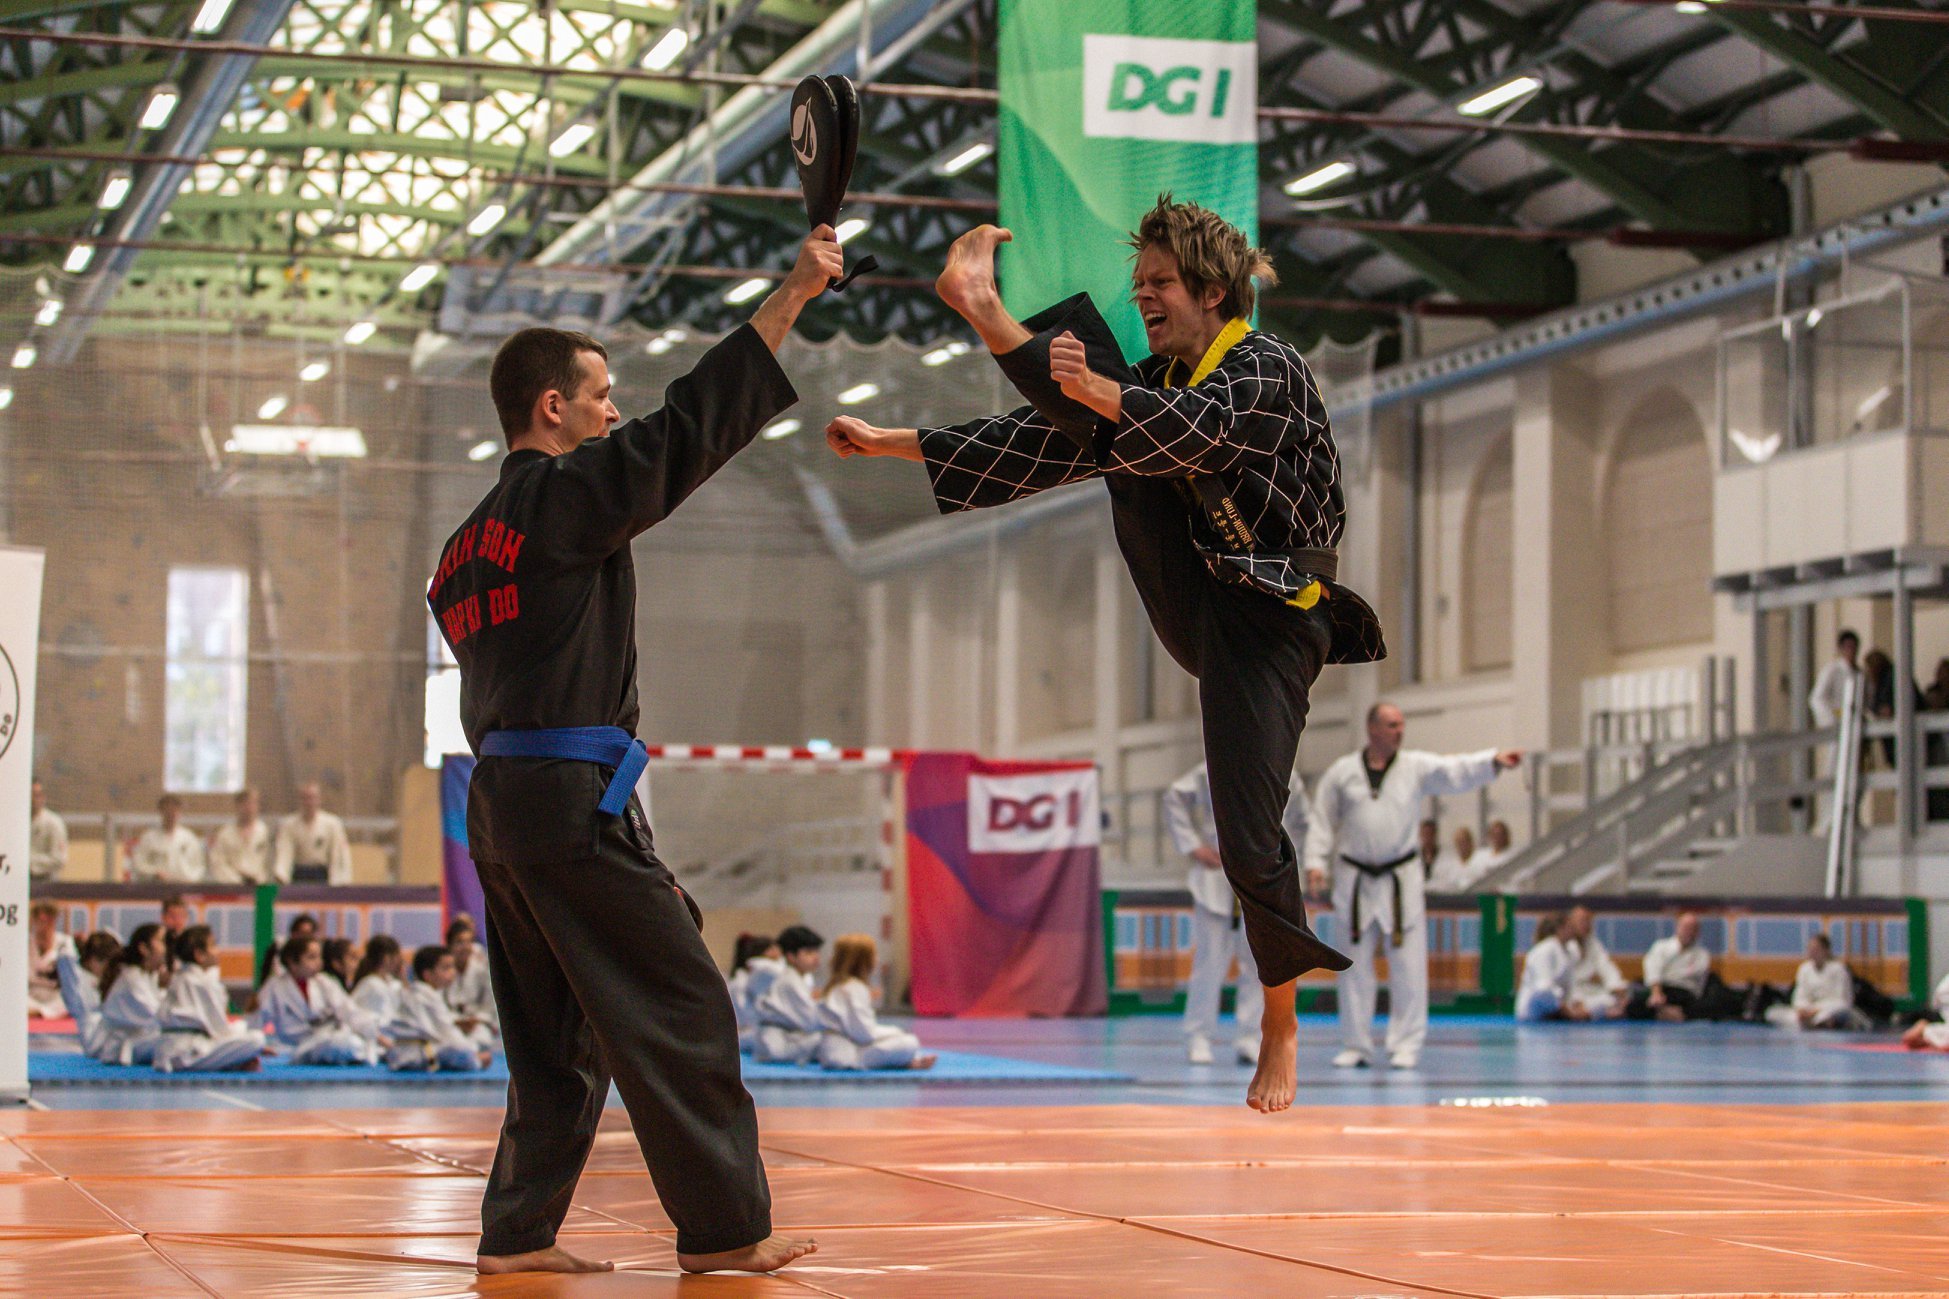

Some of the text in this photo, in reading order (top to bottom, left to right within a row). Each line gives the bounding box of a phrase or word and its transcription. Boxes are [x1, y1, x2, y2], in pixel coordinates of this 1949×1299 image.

[1106, 62, 1232, 117] DGI
[478, 518, 526, 573] SON
[488, 583, 519, 626] DO
[987, 789, 1079, 832] DGI
